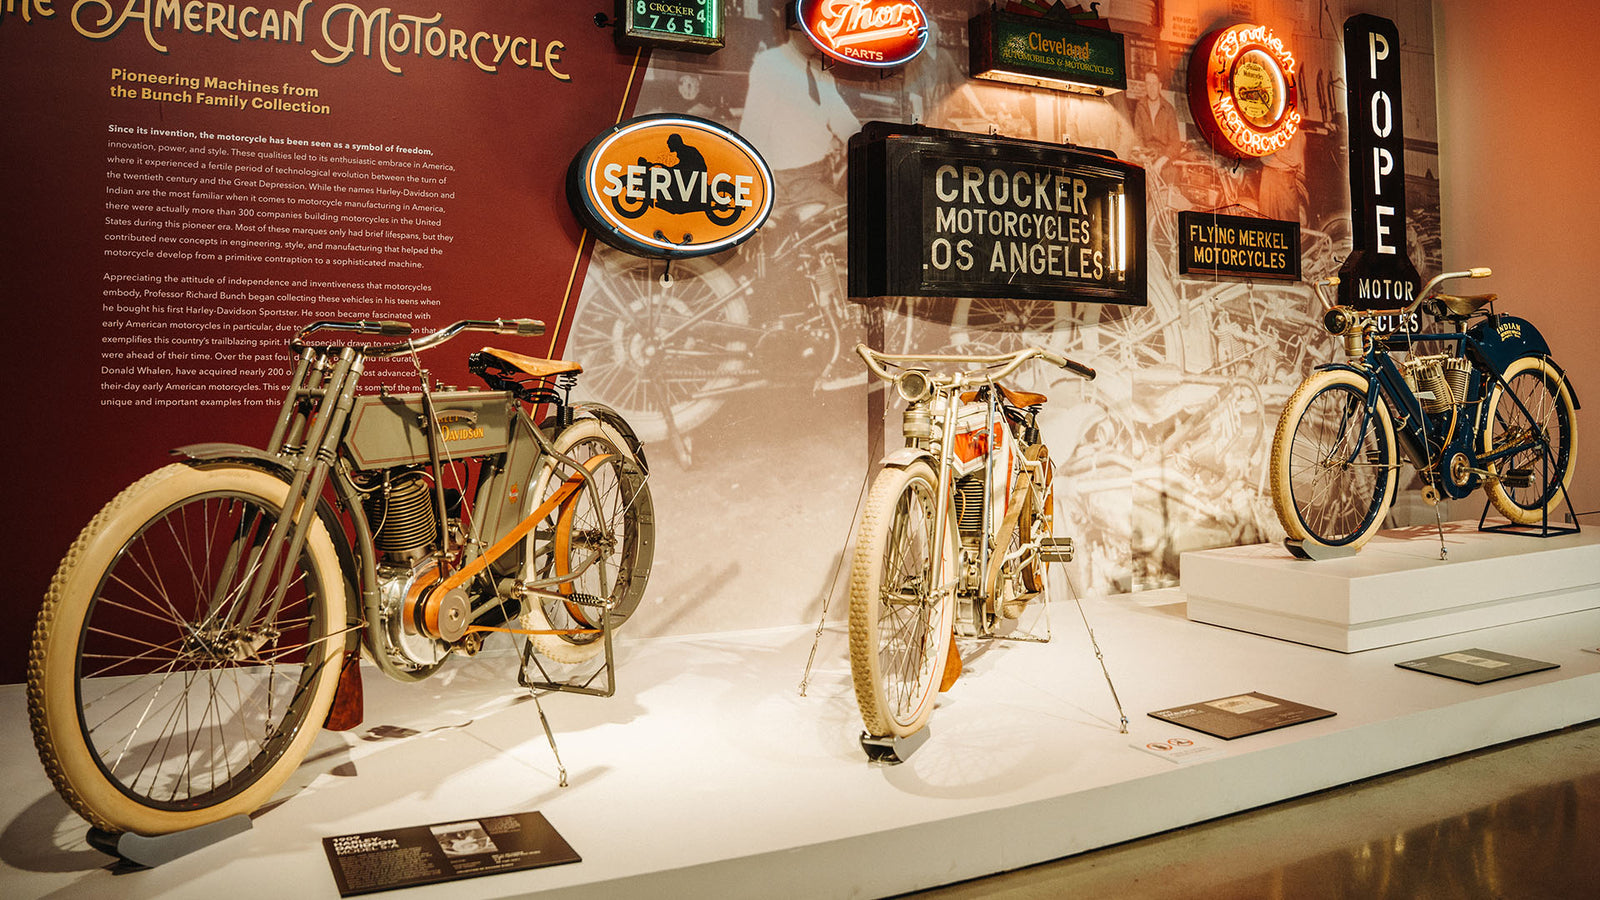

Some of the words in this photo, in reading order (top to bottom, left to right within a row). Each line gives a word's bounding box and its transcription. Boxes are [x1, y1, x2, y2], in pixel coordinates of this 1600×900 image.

[650, 2, 694, 16] CROCKER
[697, 10, 706, 23] 4
[817, 0, 918, 40] Thor
[650, 14, 660, 29] 7
[666, 18, 676, 32] 6
[684, 20, 694, 34] 5
[71, 0, 312, 52] AMERICAN
[311, 2, 570, 80] MOTORCYCLE
[844, 47, 884, 60] PARTS
[1028, 32, 1090, 60] Cleveland
[1002, 47, 1056, 66] AUTOMOBILES
[1056, 58, 1064, 66] &
[1065, 60, 1114, 75] MOTORCYCLES
[111, 68, 200, 90] Pioneering
[203, 76, 279, 95] Machines
[282, 82, 319, 98] from
[110, 86, 138, 100] the
[141, 87, 192, 104] Bunch
[196, 92, 247, 110] Family
[251, 97, 331, 115] Collection
[1220, 95, 1302, 152] MOTORCYCLES
[108, 124, 134, 133] Since
[136, 126, 148, 134] its
[150, 127, 197, 139] invention,
[199, 131, 214, 139] the
[216, 134, 267, 143] motorcycle
[269, 136, 284, 144] has
[286, 137, 308, 145] been
[351, 143, 383, 151] symbol
[395, 145, 433, 156] freedom,
[1368, 32, 1396, 255] POPE
[106, 155, 134, 164] where
[144, 159, 199, 168] experienced
[208, 161, 232, 170] fertile
[234, 164, 263, 172] period
[275, 166, 330, 177] technological
[332, 171, 369, 179] evolution
[370, 172, 405, 181] between
[406, 174, 420, 182] the
[107, 139, 156, 151] innovation,
[157, 145, 187, 153] power,
[207, 147, 229, 156] style.
[230, 148, 256, 157] These
[257, 151, 292, 159] qualities
[293, 152, 307, 160] led
[318, 154, 328, 162] its
[329, 156, 376, 165] enthusiastic
[377, 159, 412, 168] embrace
[421, 162, 455, 171] America,
[106, 170, 121, 178] the
[122, 172, 164, 181] twentieth
[165, 176, 198, 185] century
[217, 177, 232, 185] the
[233, 178, 257, 186] Great
[258, 180, 307, 189] Depression.
[308, 183, 332, 191] While
[333, 184, 346, 192] the
[375, 187, 438, 197] Harley-Davidson
[440, 191, 455, 199] and
[602, 162, 754, 208] SERVICE
[936, 164, 1088, 216] CROCKER
[936, 206, 1090, 244] MOTORCYCLES
[1190, 224, 1235, 246] FLYING
[1239, 229, 1290, 250] MERKEL
[104, 233, 156, 242] contributed
[178, 237, 218, 246] concepts
[229, 239, 282, 249] engineering,
[284, 241, 306, 250] style,
[324, 242, 382, 254] manufacturing
[384, 245, 400, 253] that
[401, 245, 428, 255] helped
[104, 249, 154, 259] motorcycle
[156, 250, 192, 260] develop
[194, 251, 215, 259] from
[224, 253, 262, 262] primitive
[264, 256, 314, 264] contraption
[332, 258, 386, 266] sophisticated
[388, 260, 424, 268] machine.
[922, 238, 974, 271] OS
[990, 240, 1103, 280] ANGELES
[1194, 246, 1286, 270] MOTORCYCLES
[102, 272, 162, 284] Appreciating
[164, 274, 178, 282] the
[227, 277, 289, 286] independence
[291, 279, 307, 287] and
[309, 280, 364, 288] inventiveness
[366, 281, 382, 289] that
[383, 283, 432, 292] motorcycles
[1359, 278, 1414, 301] MOTOR
[102, 288, 142, 298] embody,
[143, 289, 184, 298] Professor
[185, 290, 218, 299] Richard
[219, 291, 246, 299] Bunch
[248, 292, 274, 302] began
[276, 293, 316, 303] collecting
[318, 294, 340, 302] these
[341, 295, 374, 303] vehicles
[384, 296, 396, 304] his
[116, 304, 150, 314] bought
[152, 305, 164, 313] his
[166, 304, 183, 313] first
[185, 306, 256, 316] Harley-Davidson
[258, 307, 299, 317] Sportster.
[337, 309, 370, 318] became
[371, 310, 412, 319] fascinated
[1496, 322, 1521, 334] INDIAN
[442, 425, 484, 442] DAVIDSON
